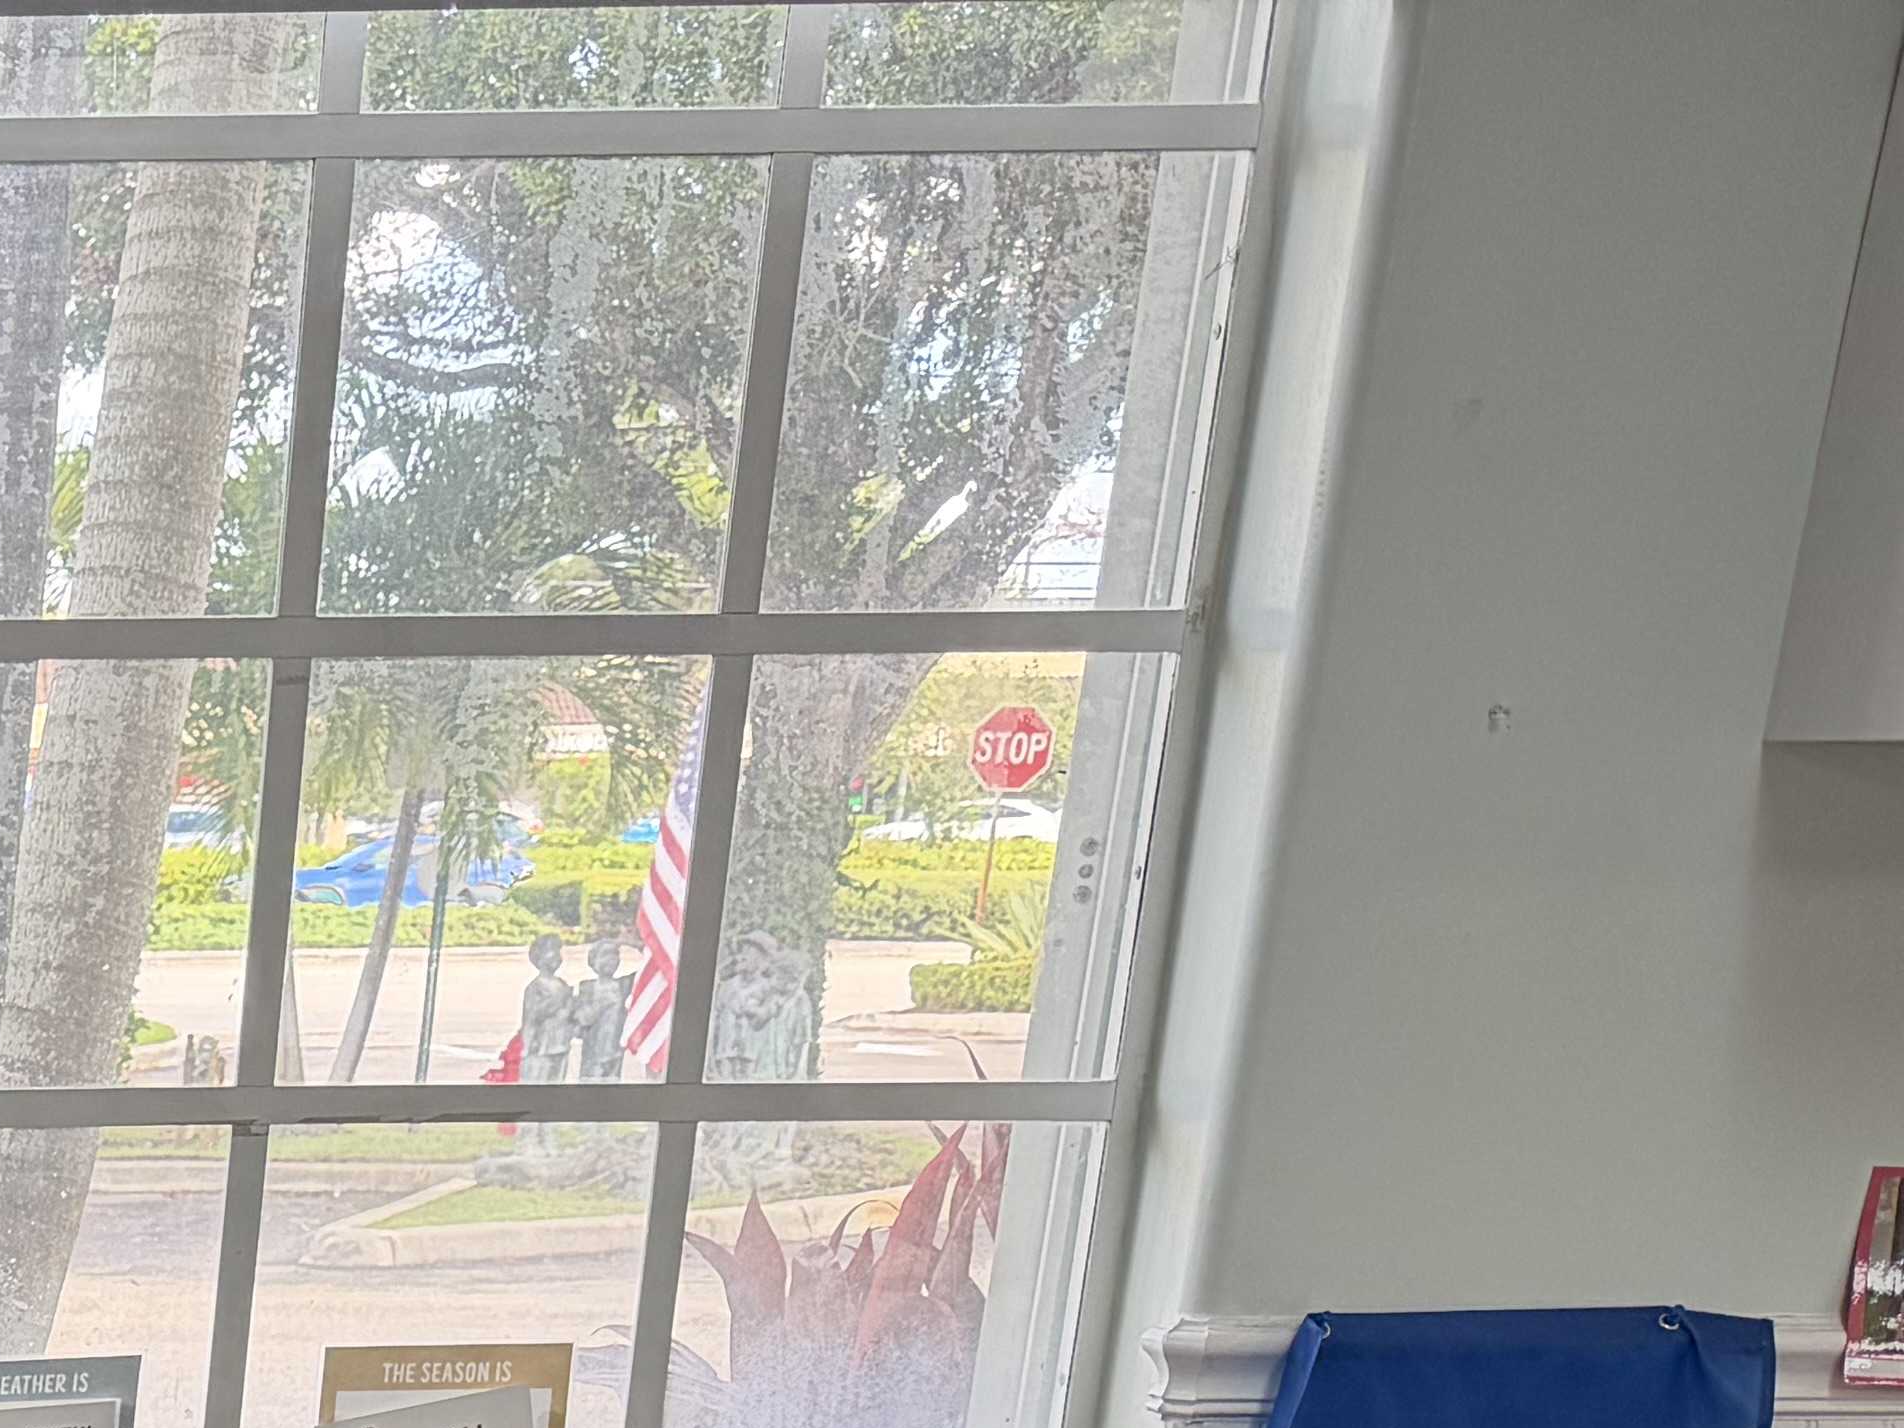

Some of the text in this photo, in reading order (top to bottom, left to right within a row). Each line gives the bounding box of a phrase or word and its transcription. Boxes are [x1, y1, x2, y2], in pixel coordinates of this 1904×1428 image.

[974, 730, 1052, 769] STOP
[72, 1372, 89, 1392] IS
[382, 1361, 512, 1383] THE SEASON IS
